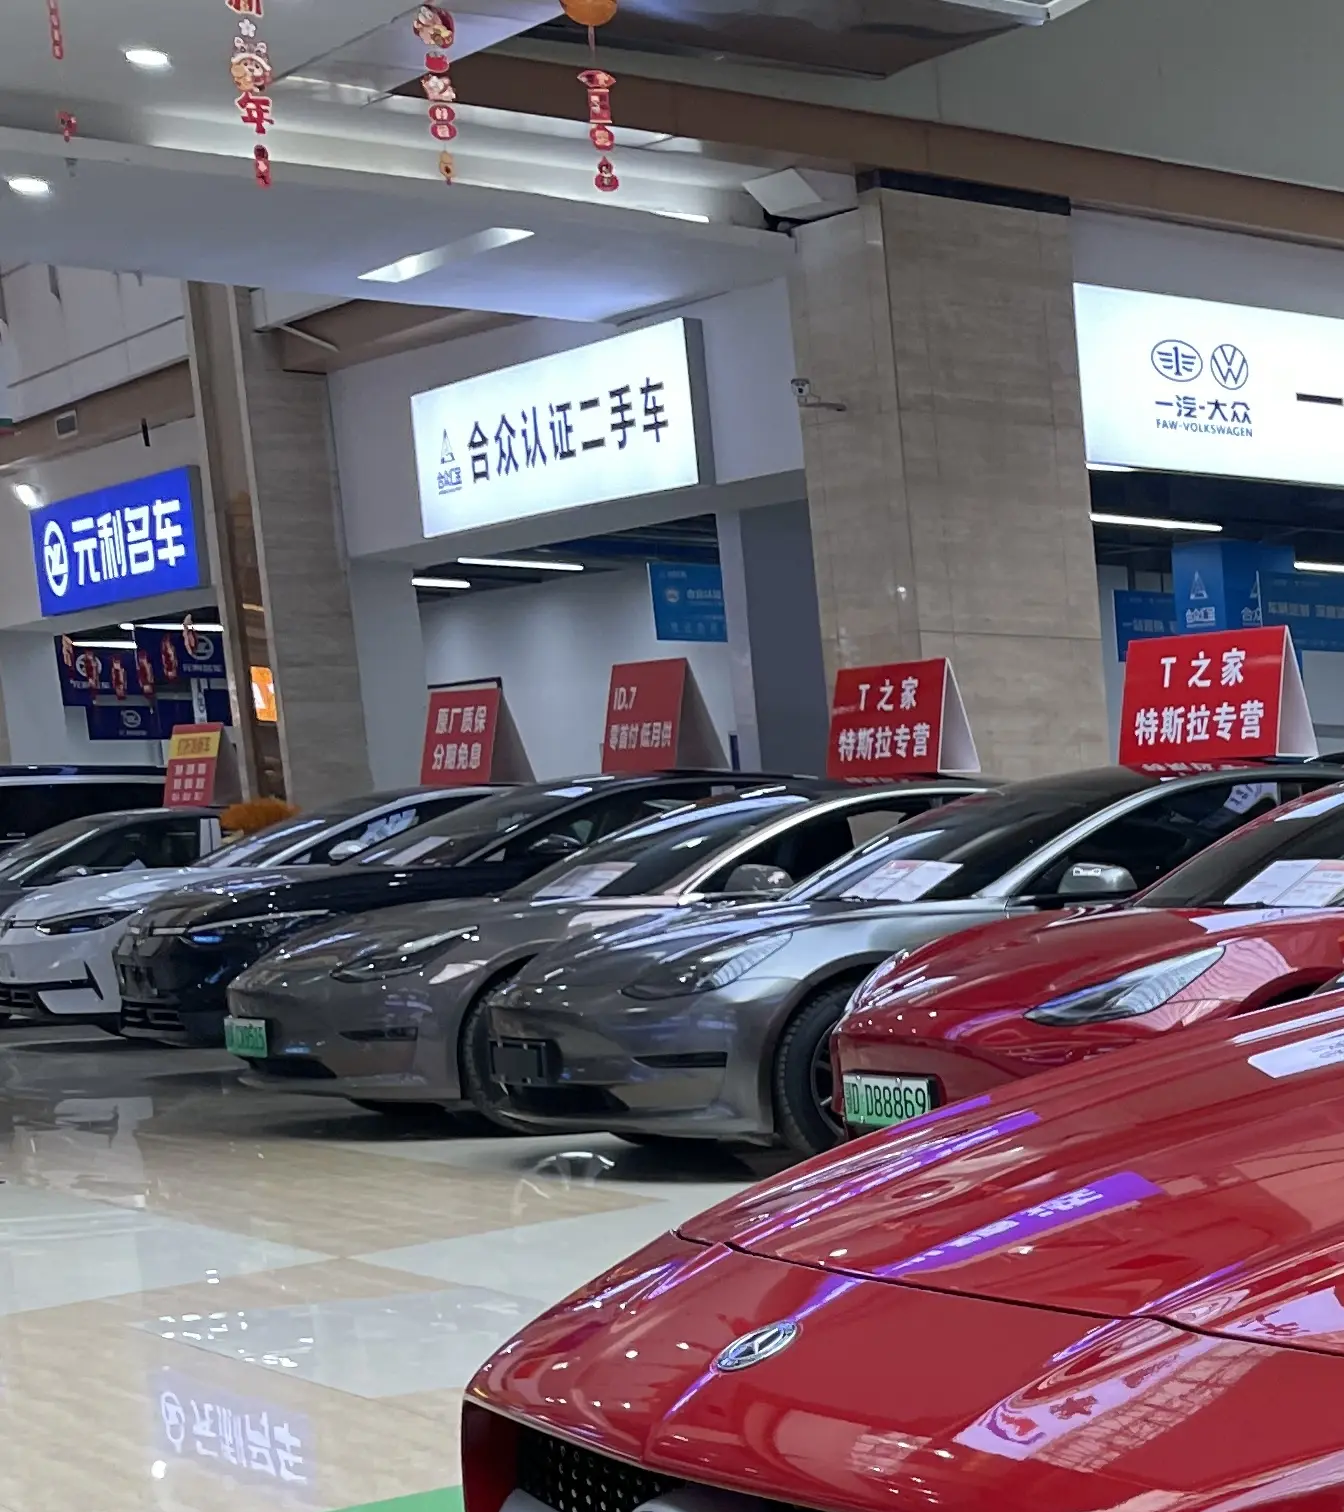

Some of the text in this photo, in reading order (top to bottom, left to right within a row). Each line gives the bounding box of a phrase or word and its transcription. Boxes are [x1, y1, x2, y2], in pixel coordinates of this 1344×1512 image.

[1154, 394, 1252, 425] 一汽-大众
[468, 377, 669, 484] 合众认证二手车
[1155, 417, 1254, 438] FAW-VOLKSWAGEN
[71, 498, 186, 587] 元利名车
[613, 686, 637, 712] ID.7
[435, 705, 488, 735] 原厂质保
[1134, 699, 1265, 747] 特斯拉专营
[431, 743, 482, 770] 分期免息
[838, 722, 931, 762] 特斯拉专营
